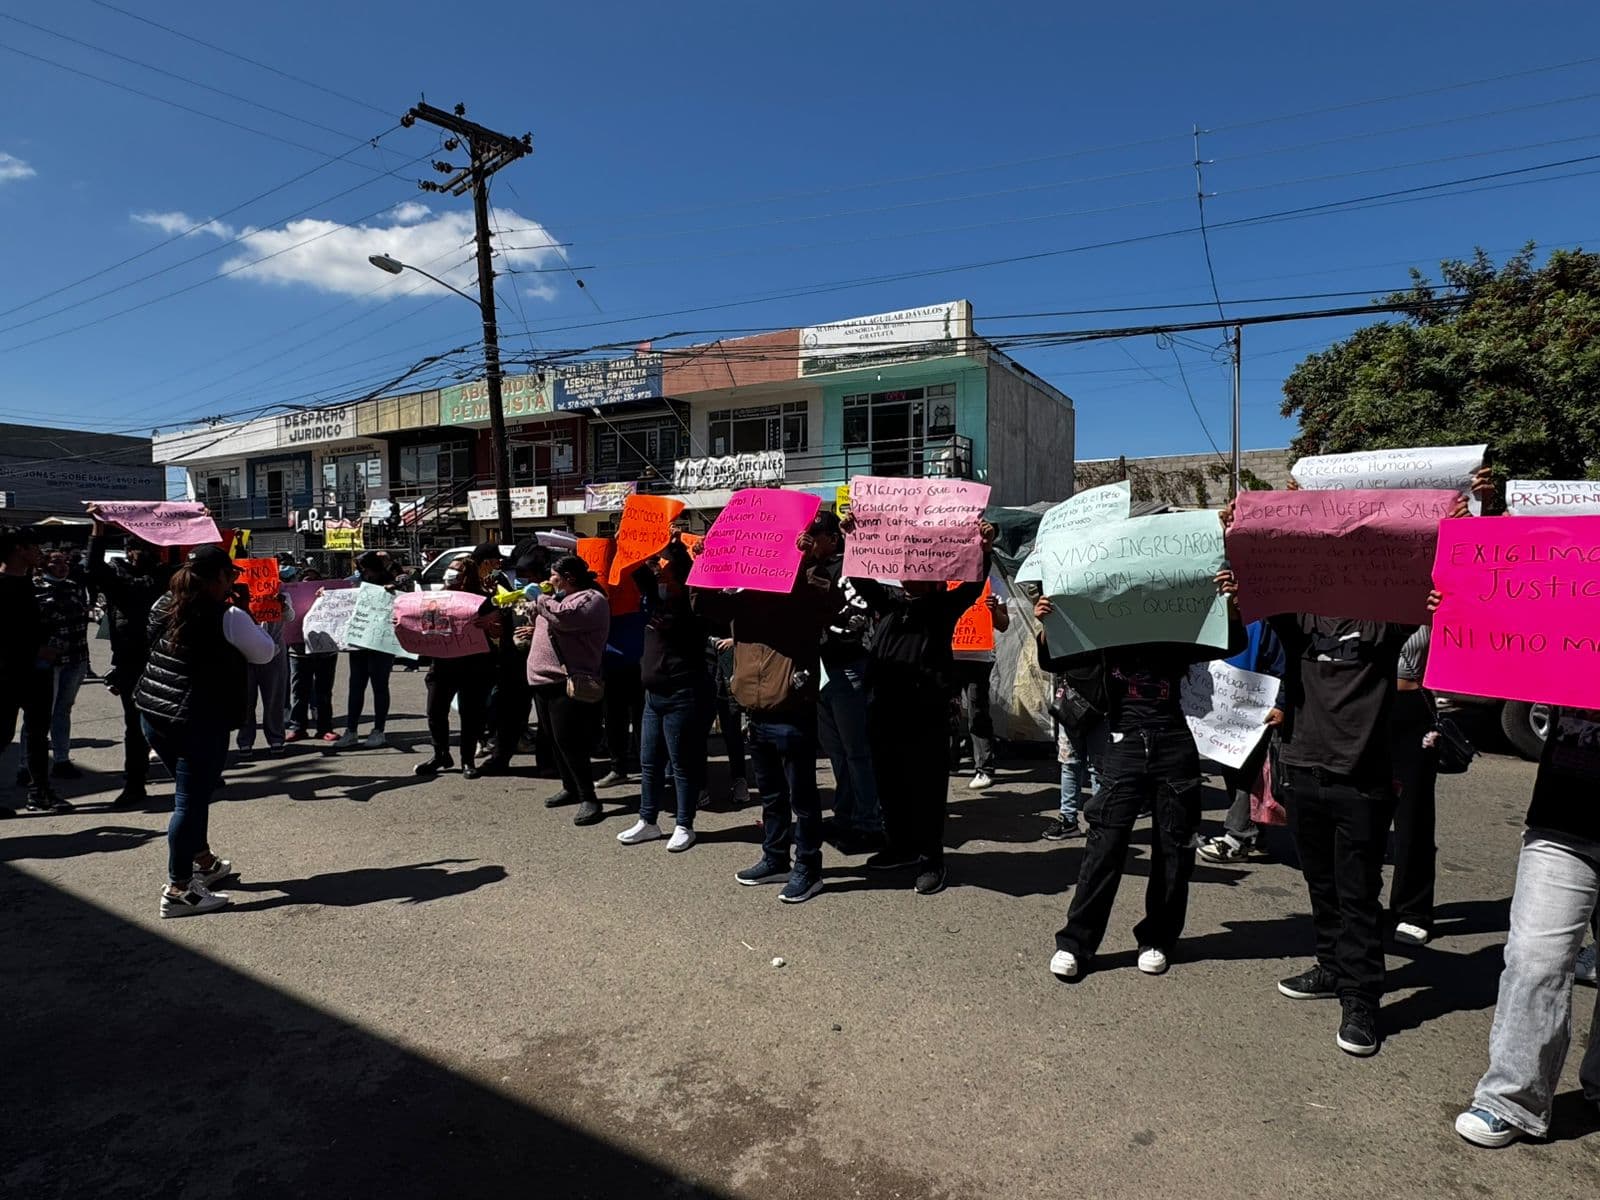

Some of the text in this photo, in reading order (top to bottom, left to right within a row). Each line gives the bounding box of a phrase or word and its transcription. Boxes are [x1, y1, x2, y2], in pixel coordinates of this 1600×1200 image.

[869, 312, 903, 325] AGUILAR
[859, 330, 894, 340] GRATUITA
[607, 369, 647, 383] GRATUITA
[285, 409, 346, 428] DESPACHO
[289, 424, 342, 442] JURIDICO
[739, 458, 783, 472] OFICIALES
[1053, 541, 1110, 567] VIVOS
